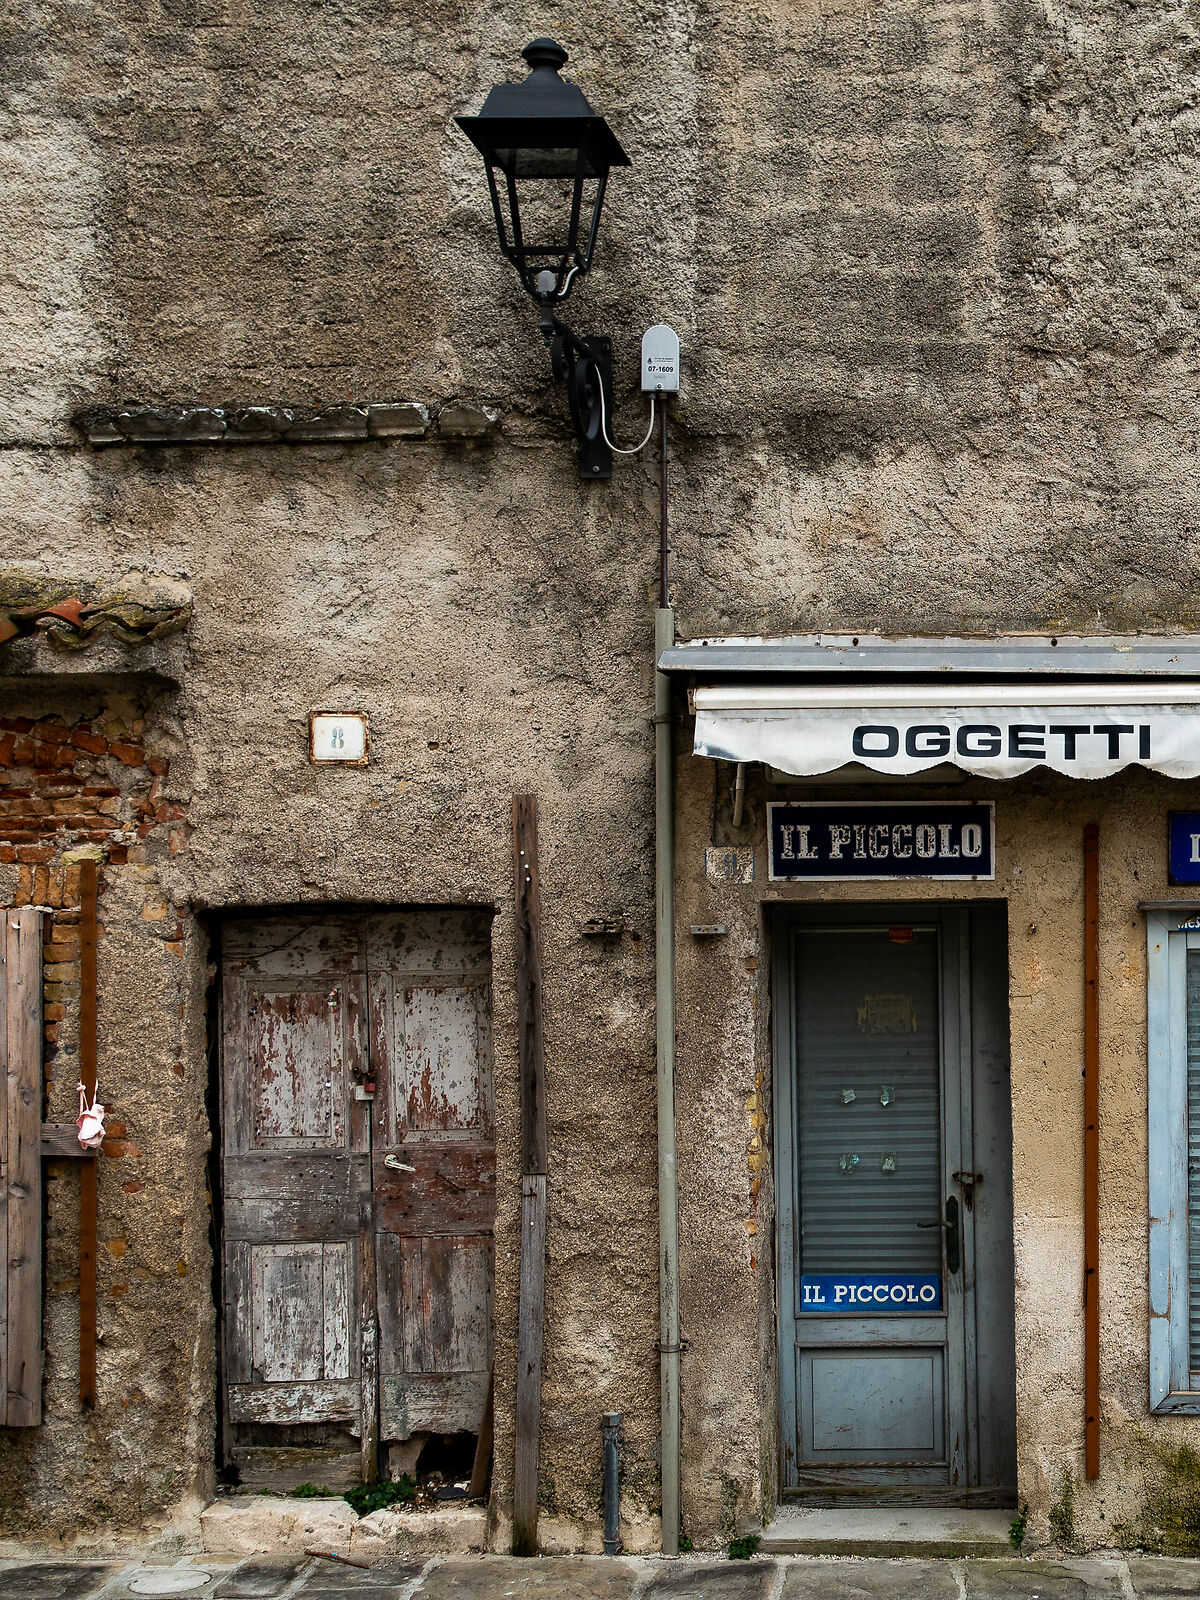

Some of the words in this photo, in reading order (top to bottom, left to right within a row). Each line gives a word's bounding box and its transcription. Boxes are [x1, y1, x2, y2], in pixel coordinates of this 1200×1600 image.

[331, 726, 345, 749] 8
[852, 724, 1151, 760] OGGETTI
[780, 824, 819, 860] IL
[828, 823, 983, 859] PICCOLO
[803, 1285, 826, 1303] IL
[833, 1284, 936, 1303] PICCOLO
